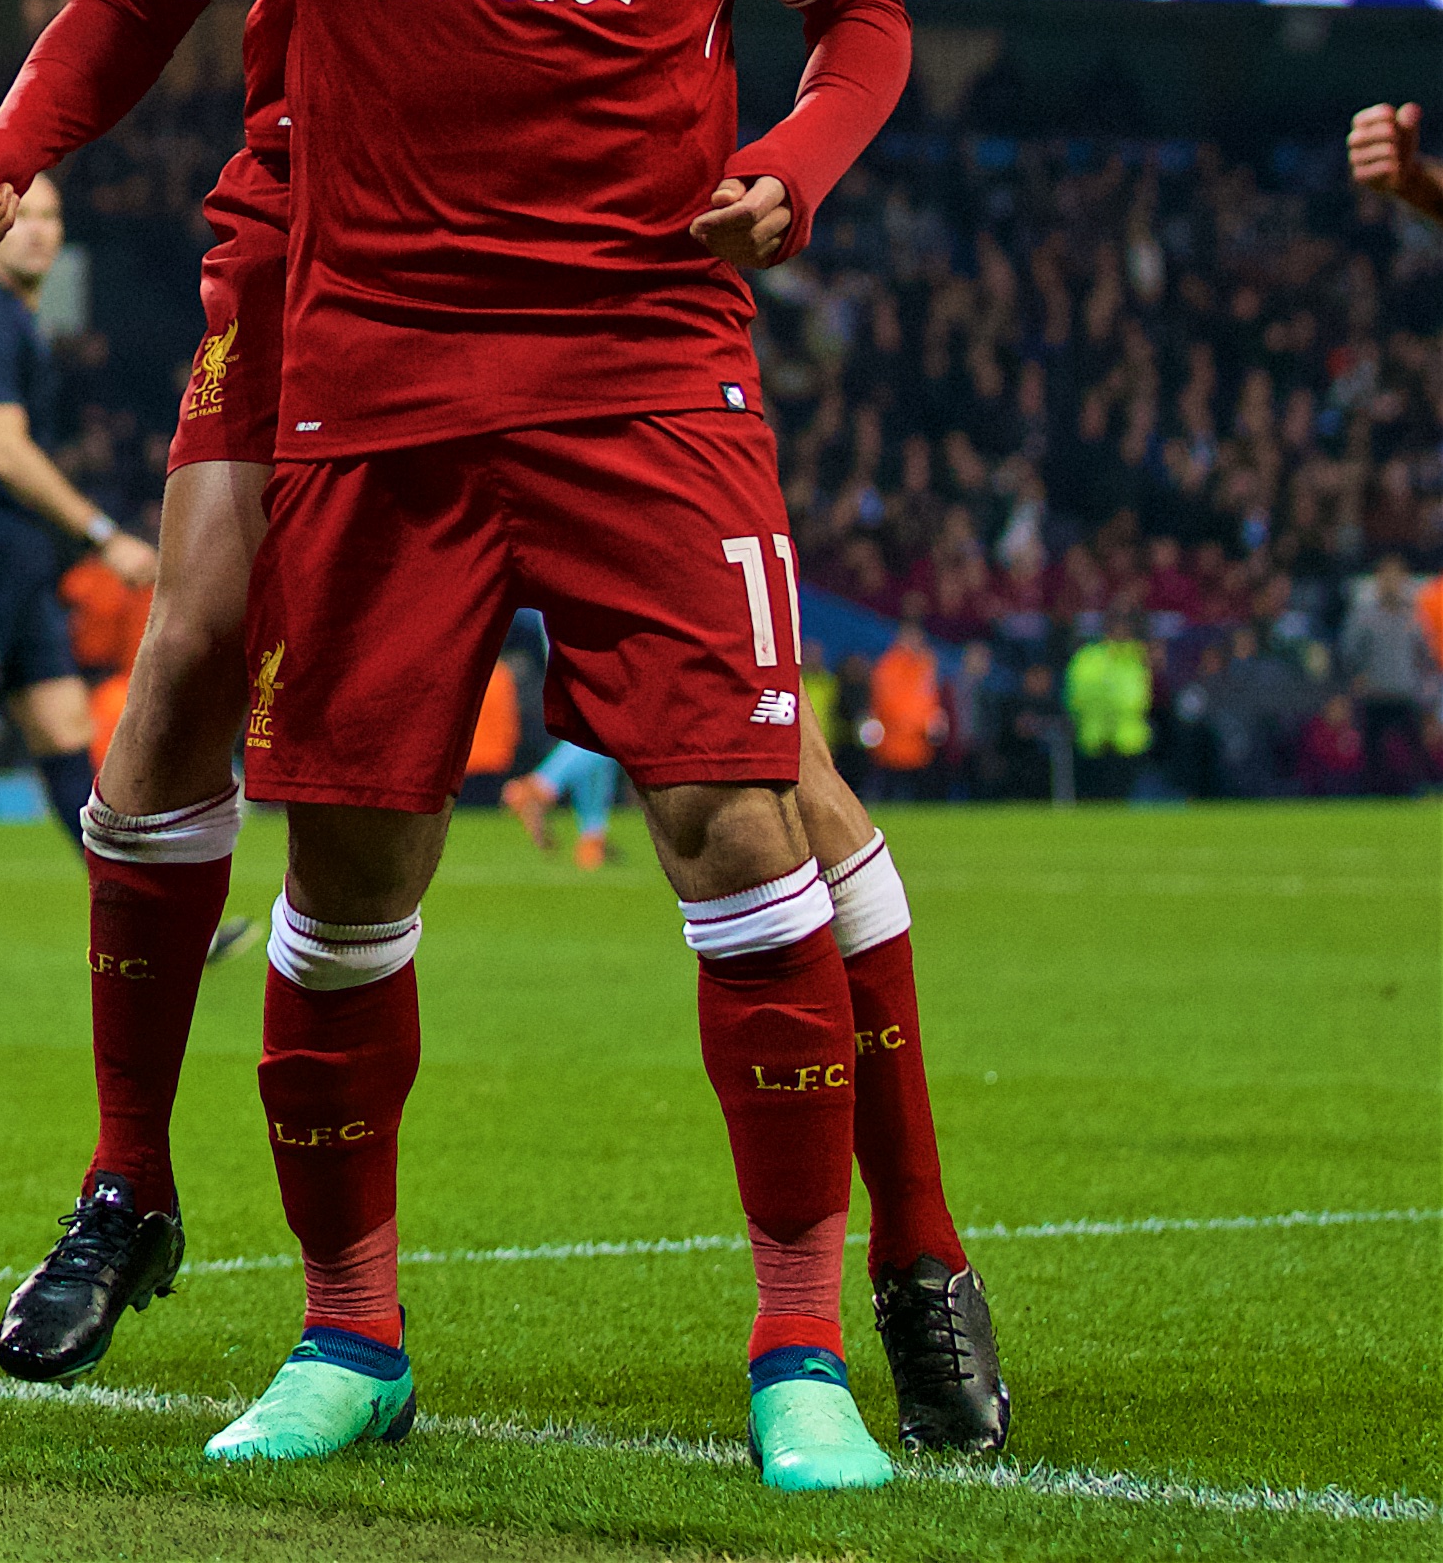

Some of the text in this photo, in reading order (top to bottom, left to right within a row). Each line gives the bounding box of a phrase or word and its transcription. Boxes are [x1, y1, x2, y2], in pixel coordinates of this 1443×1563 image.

[721, 533, 802, 667] 11
[751, 1063, 850, 1092] L.F.C.
[273, 1120, 375, 1147] L.F.C.
